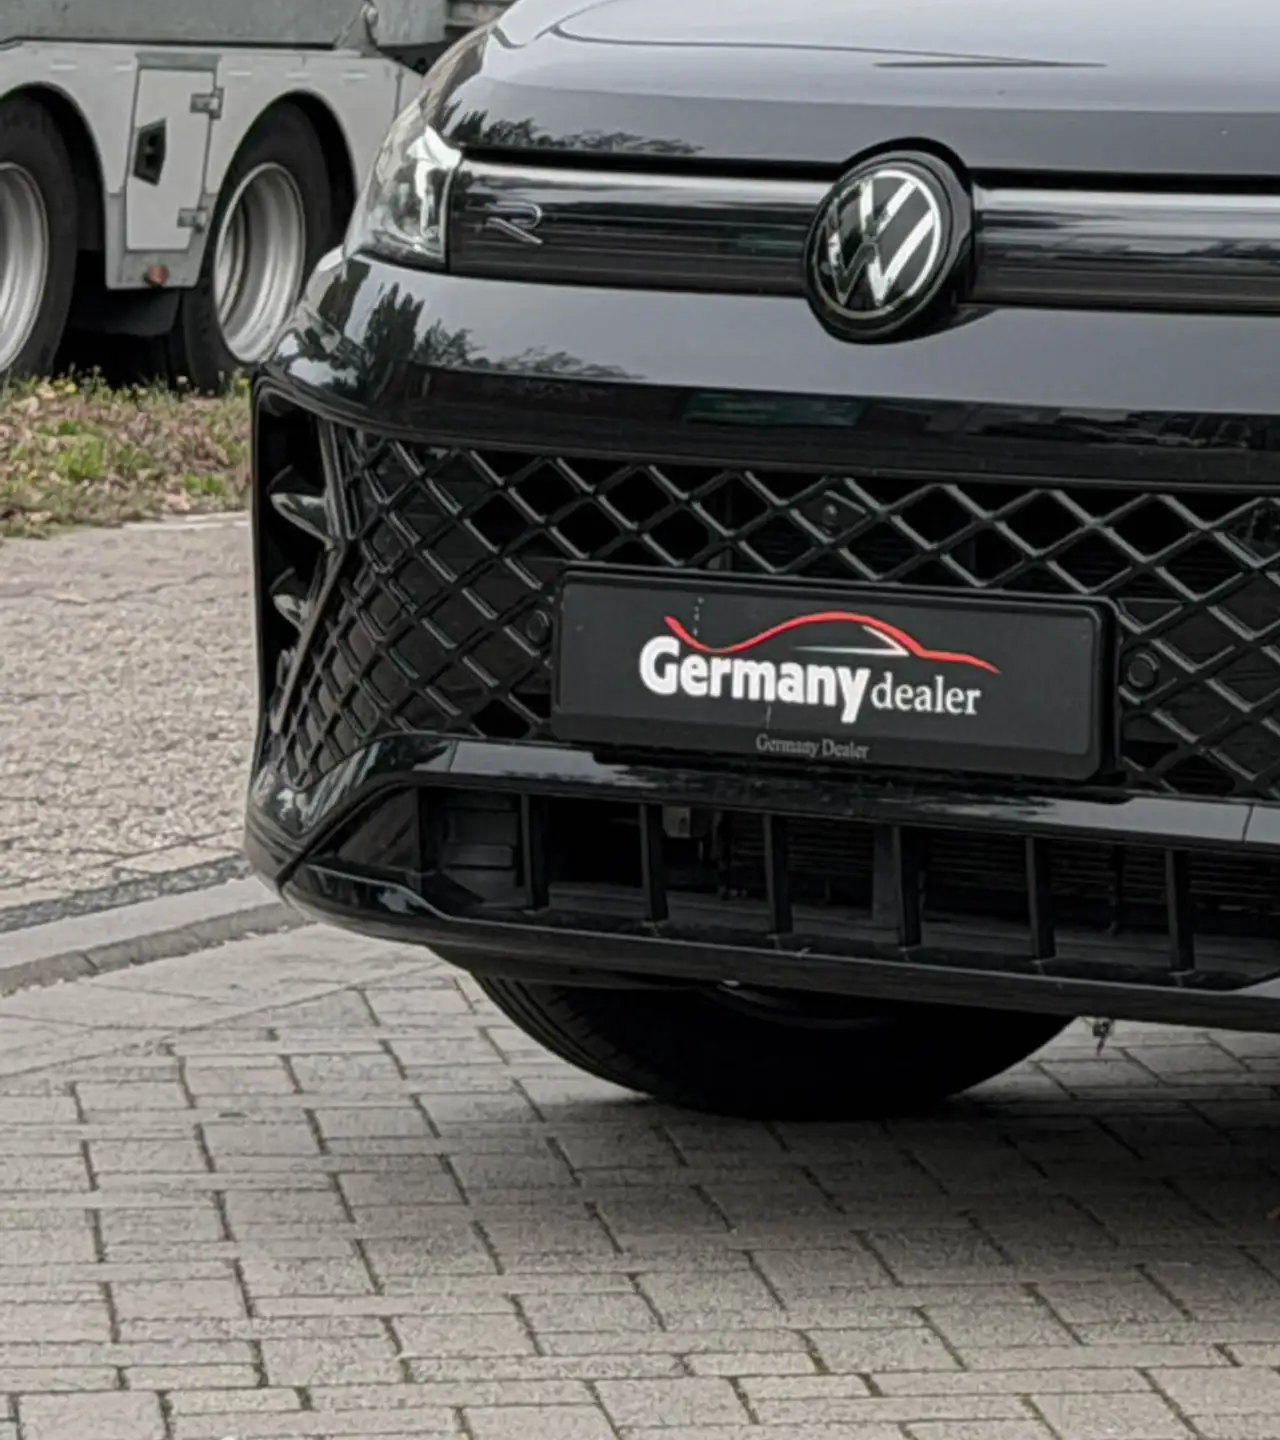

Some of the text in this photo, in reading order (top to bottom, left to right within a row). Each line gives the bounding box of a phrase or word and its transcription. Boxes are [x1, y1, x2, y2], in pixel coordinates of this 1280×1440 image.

[639, 635, 982, 724] Germany dealer
[756, 733, 870, 759] Germany Dealer
